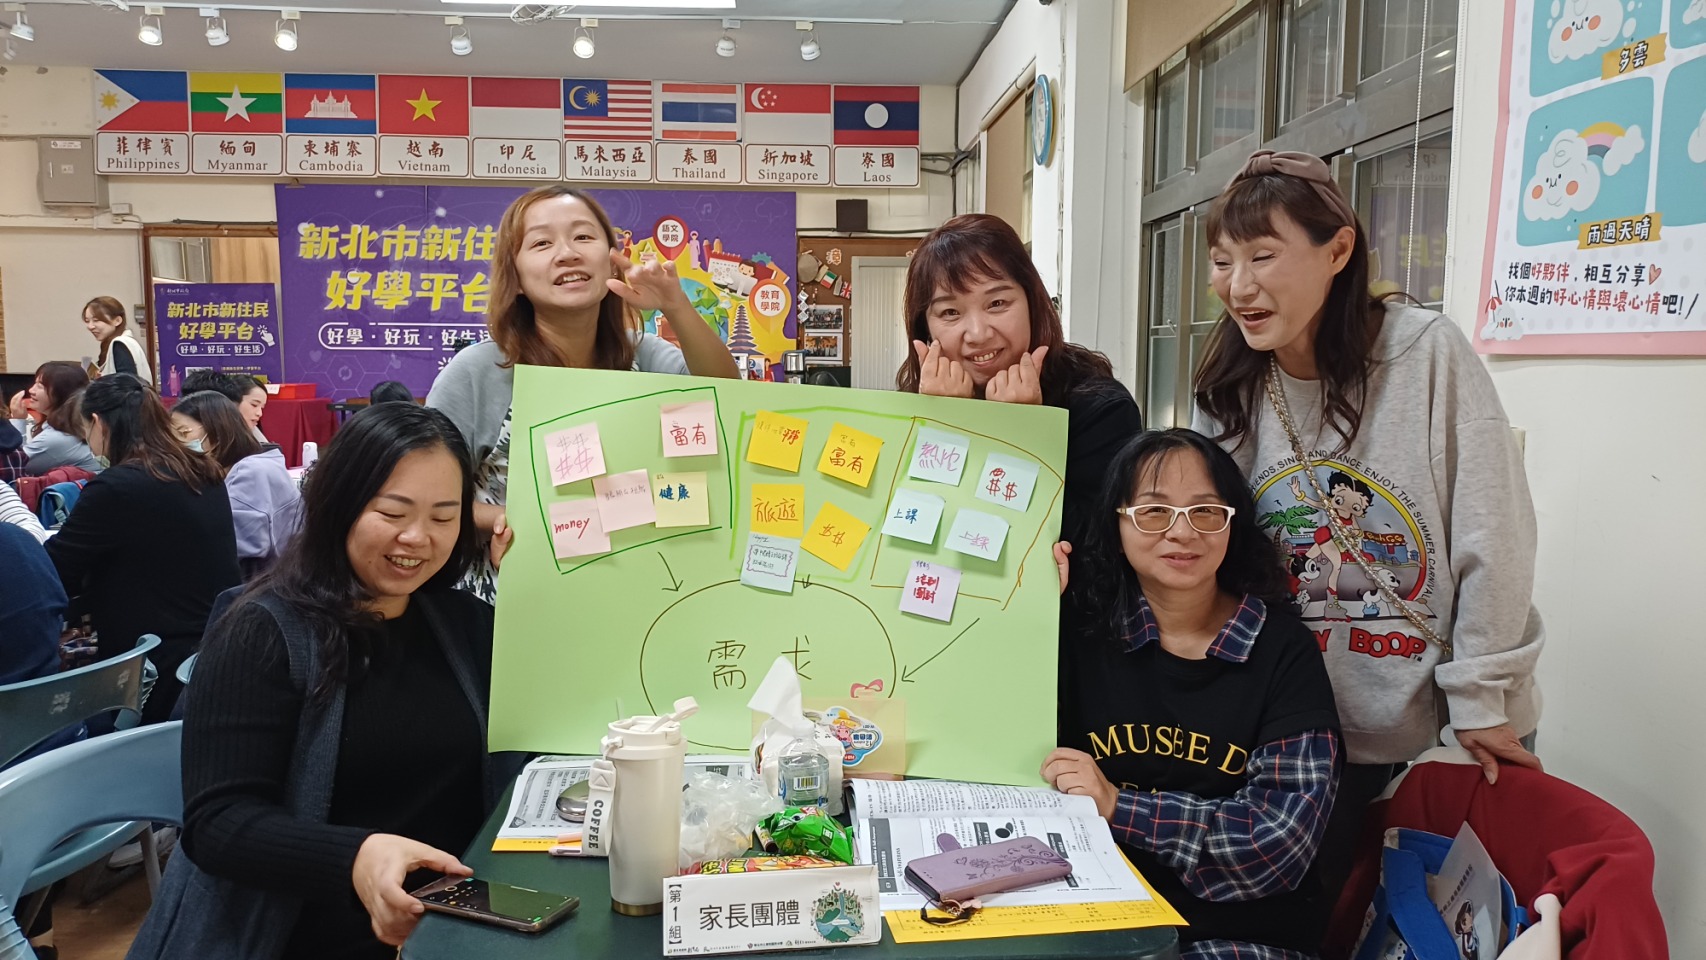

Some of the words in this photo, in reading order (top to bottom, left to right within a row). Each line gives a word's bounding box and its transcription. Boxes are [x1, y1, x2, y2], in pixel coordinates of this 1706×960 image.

[1618, 41, 1649, 73] 多雲
[116, 136, 174, 156] 菲律賓
[219, 140, 257, 157] 緬甸
[303, 139, 362, 157] 柬埔寨
[406, 140, 445, 158] 越南
[500, 143, 537, 161] 印尼
[573, 145, 646, 164] 馬來西亞
[107, 157, 180, 171] Philippines
[682, 147, 719, 165] 泰國
[761, 148, 816, 168] 新加坡
[861, 151, 895, 169] 寮國
[207, 159, 268, 174] Myanmar
[298, 159, 363, 172] Cambodia
[397, 159, 451, 173] Vietnam
[486, 162, 547, 175] Indonesia
[580, 164, 637, 179] Malaysia
[672, 166, 726, 180] Thailand
[757, 168, 819, 183] Singapore
[863, 171, 892, 182] Laos
[661, 223, 679, 233] 語文
[1587, 215, 1651, 245] 雨過天晴
[662, 234, 679, 243] 學院
[760, 290, 780, 300] 教育
[167, 301, 269, 318] 新北市新住民
[760, 301, 780, 311] 學院
[178, 321, 254, 341] 好學平台
[669, 422, 707, 446] 富有
[829, 446, 864, 474] 富有
[658, 483, 691, 502] 健康
[1397, 490, 1417, 511] THE
[754, 497, 799, 523] 旅遊
[893, 508, 918, 525] 上課
[553, 517, 590, 539] money
[1413, 511, 1436, 555] SUMMER
[1421, 557, 1437, 599] CARNIVAL
[1348, 626, 1427, 659] BOOP
[707, 634, 813, 690] 需求
[588, 799, 605, 849] COFFEE
[699, 899, 801, 932] 家長團體
